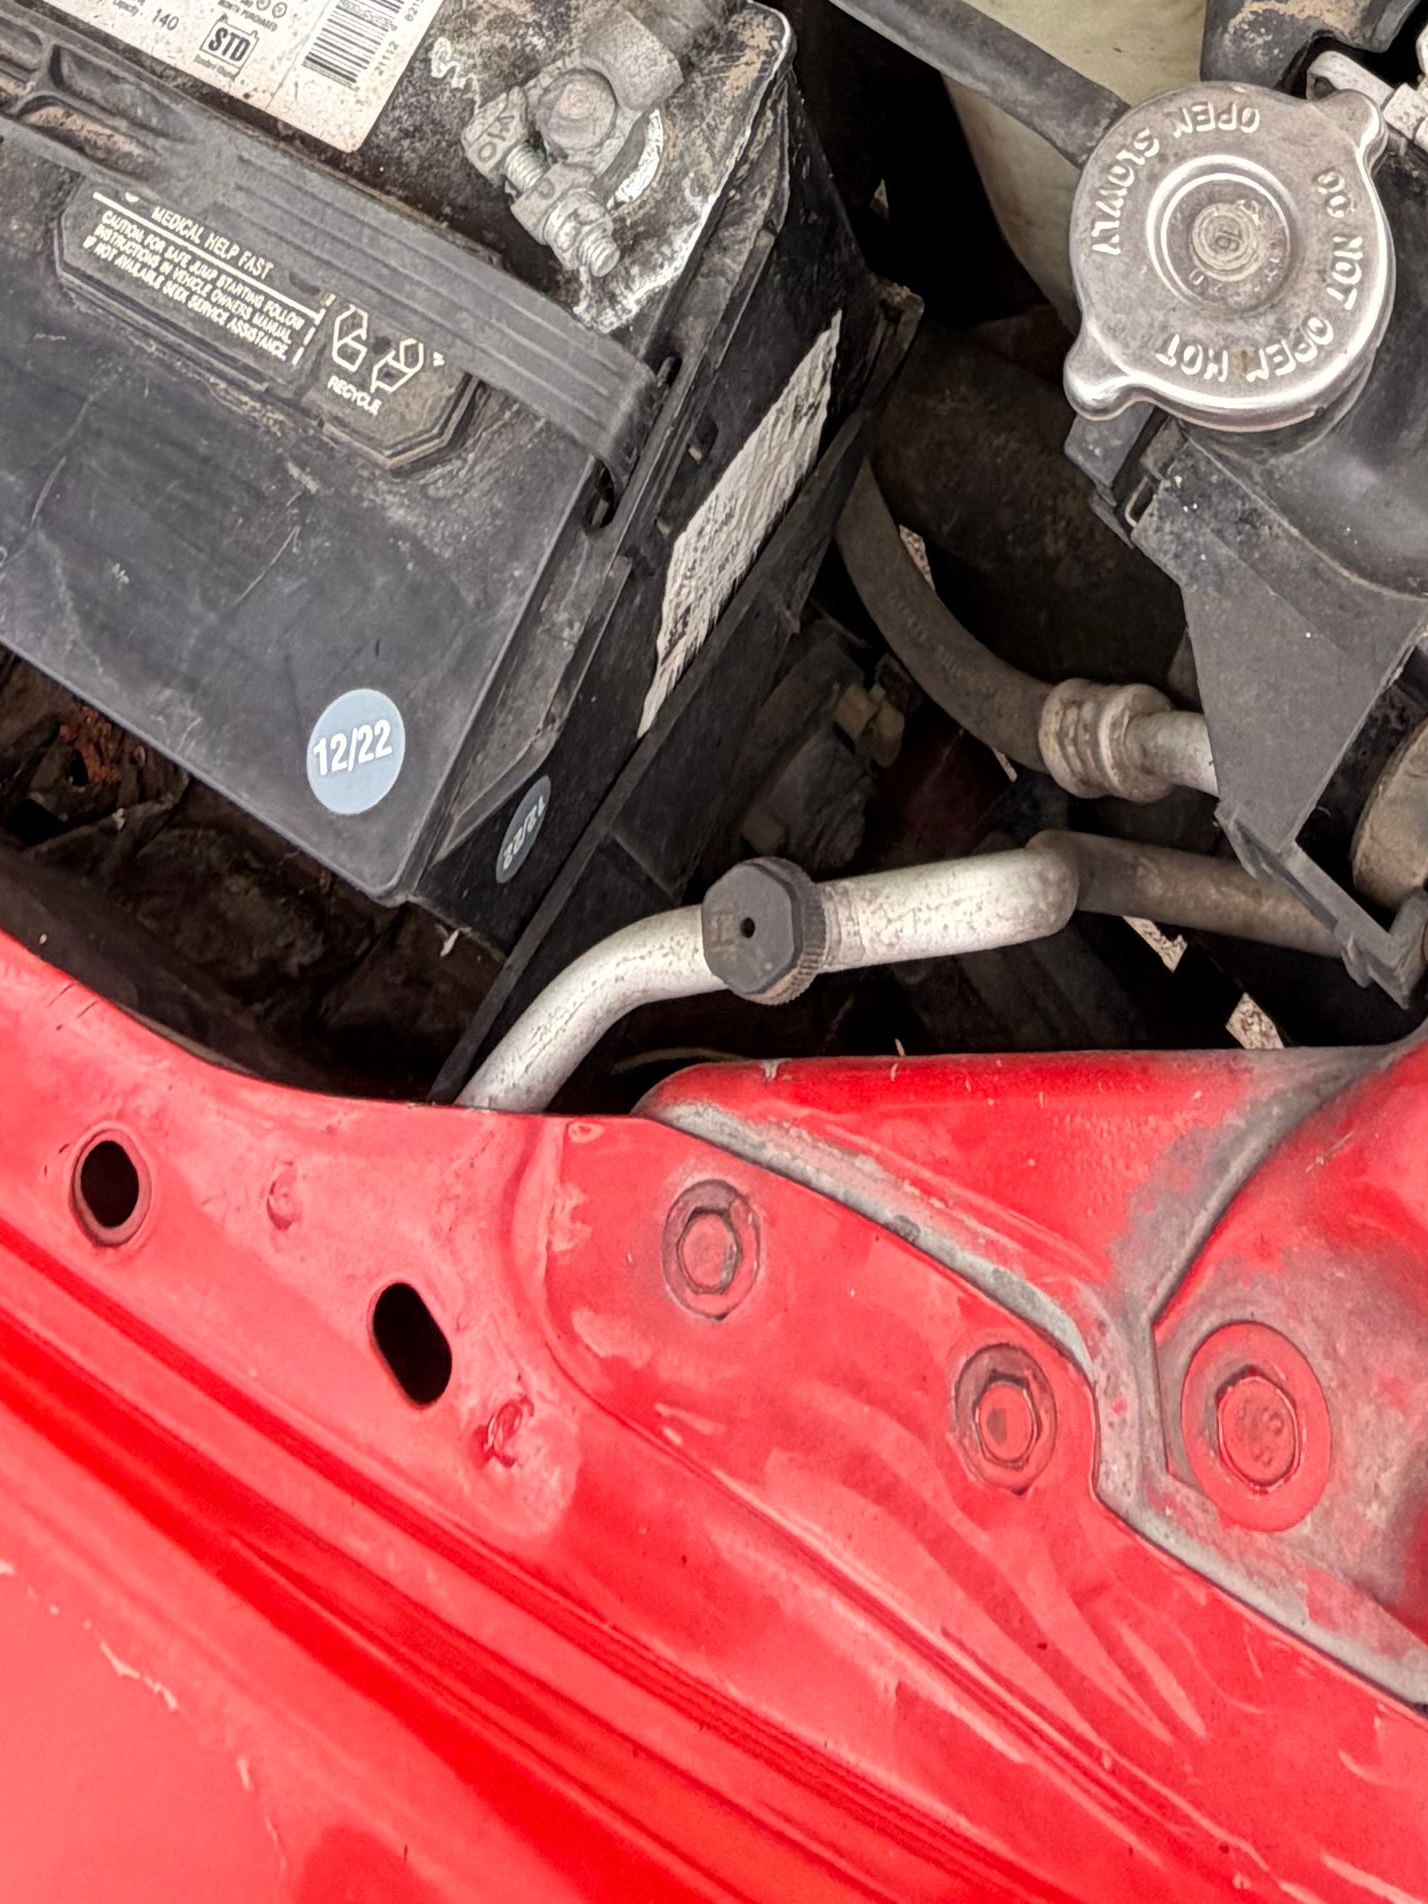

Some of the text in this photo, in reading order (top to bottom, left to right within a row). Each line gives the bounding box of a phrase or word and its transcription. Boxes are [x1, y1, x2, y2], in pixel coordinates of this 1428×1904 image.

[152, 8, 180, 31] 140
[208, 27, 251, 62] STD
[1173, 100, 1261, 138] OPEN
[1090, 127, 1161, 256] SLOWLY
[94, 224, 161, 268] INSTRUCTIONS
[160, 261, 174, 275] IN
[172, 266, 212, 298] VEHICLE
[210, 288, 253, 320] OWNERS
[102, 210, 305, 330] CAUTION: FOR SAFE JUMP STARTING FOLLOW
[151, 206, 274, 280] MEDICAL HELP FAST
[1326, 234, 1364, 311] NOT
[82, 235, 289, 361] IF NOT AVAILABLE SEEK SERVICE ASSISTANCE.
[1154, 333, 1230, 382] HOT
[1244, 314, 1335, 383] OPEN
[327, 375, 382, 416] RECYCLE
[312, 719, 393, 776] 12/22
